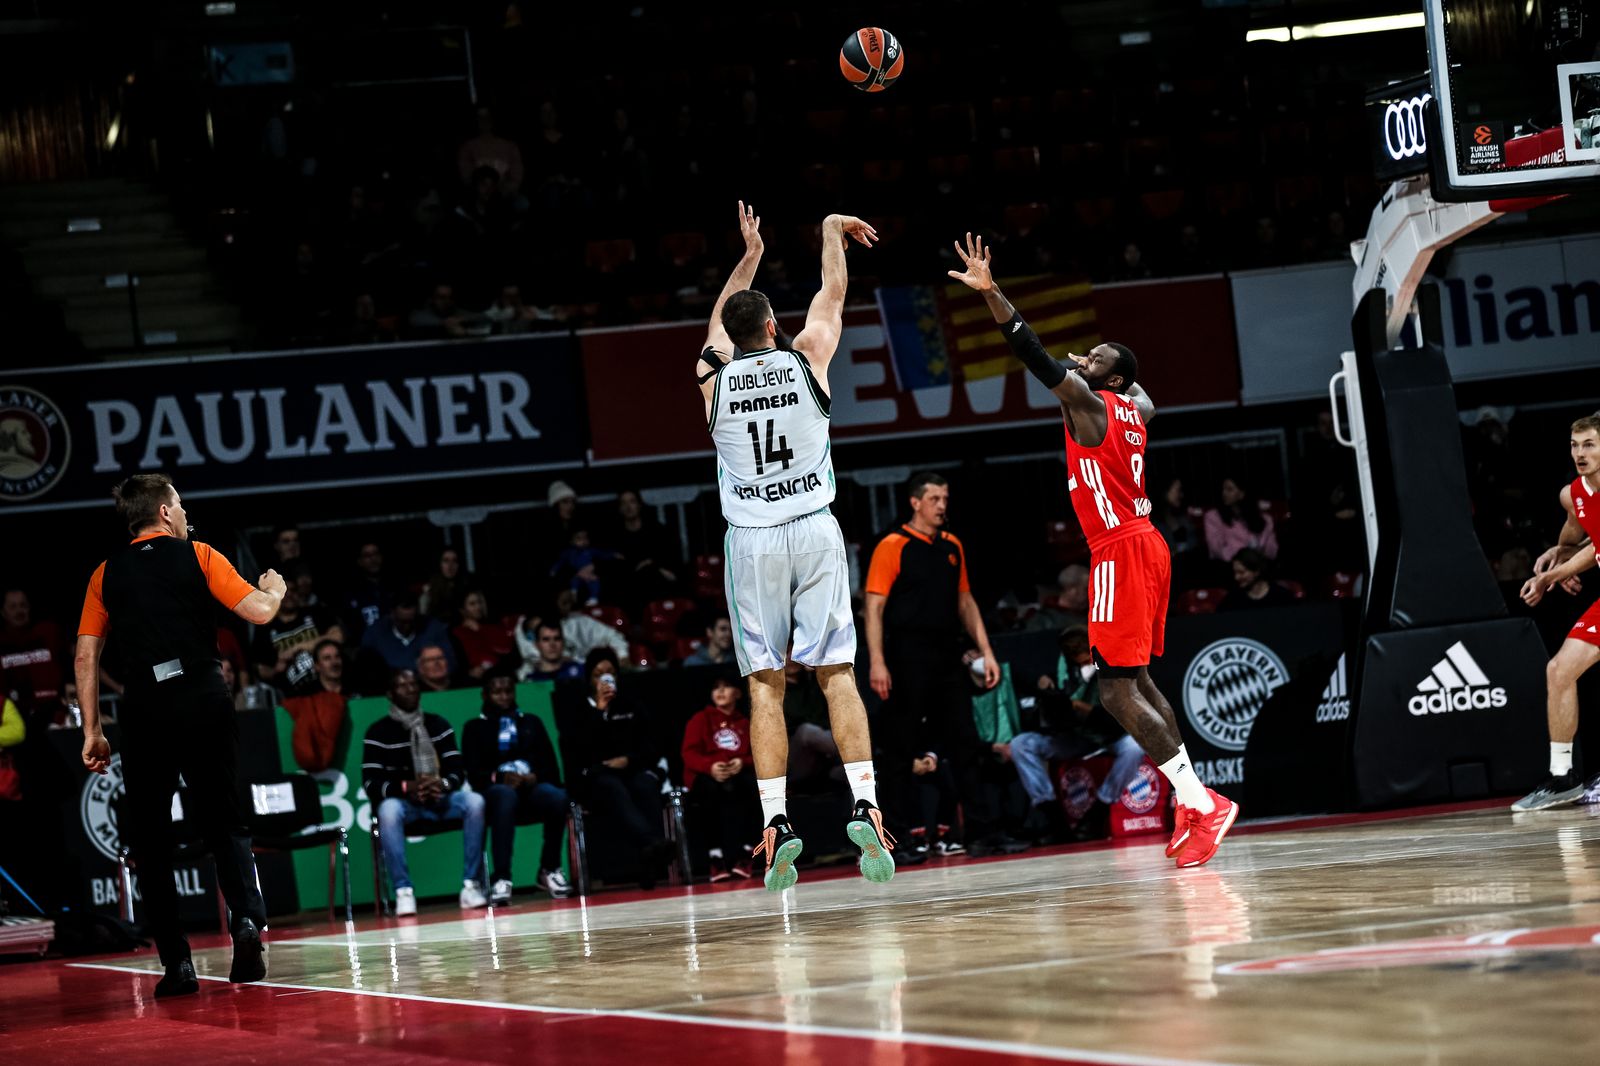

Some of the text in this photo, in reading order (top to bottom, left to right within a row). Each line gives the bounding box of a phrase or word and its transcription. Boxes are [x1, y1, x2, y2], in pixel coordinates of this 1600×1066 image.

[1470, 144, 1499, 153] TURKISH
[1470, 150, 1499, 159] AIRLINES
[1444, 273, 1600, 347] lian
[728, 367, 796, 392] DUBLJEVIC
[729, 391, 799, 415] PAMESA
[86, 371, 541, 473] PAULANER
[747, 418, 794, 475] 14
[1192, 646, 1280, 690] FC BAYERN
[1315, 695, 1350, 723] adidas
[1407, 684, 1508, 717] adidas
